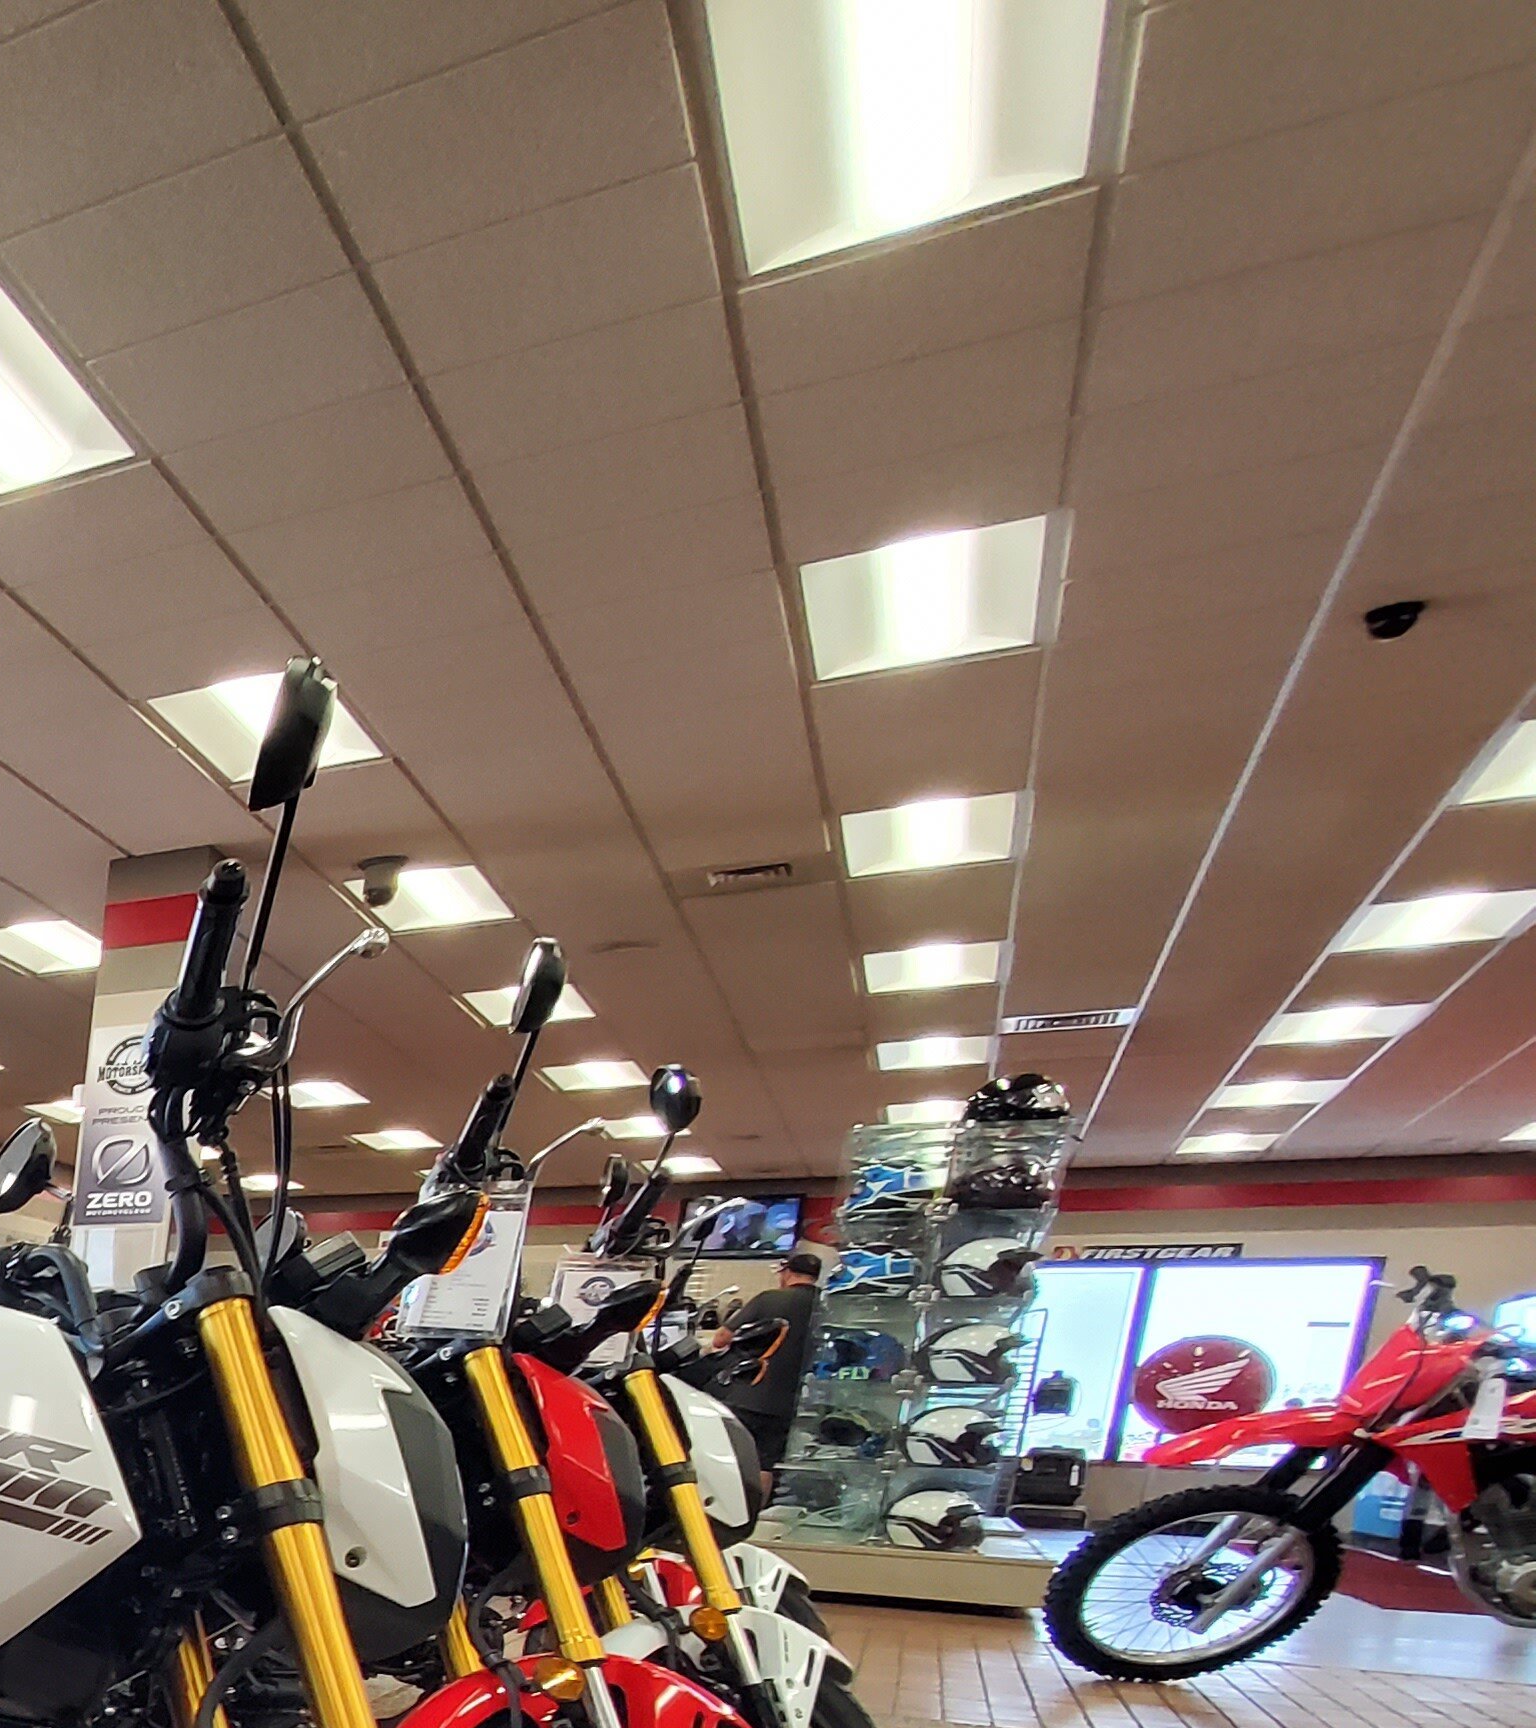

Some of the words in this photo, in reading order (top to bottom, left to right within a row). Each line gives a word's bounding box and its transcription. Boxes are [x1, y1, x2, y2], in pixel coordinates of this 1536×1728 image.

[92, 1115, 148, 1125] PRESEN
[86, 1190, 152, 1209] ZERO
[1081, 1246, 1233, 1260] FIRSTGEAR
[838, 1366, 870, 1380] FLY
[1156, 1399, 1238, 1411] HONDA
